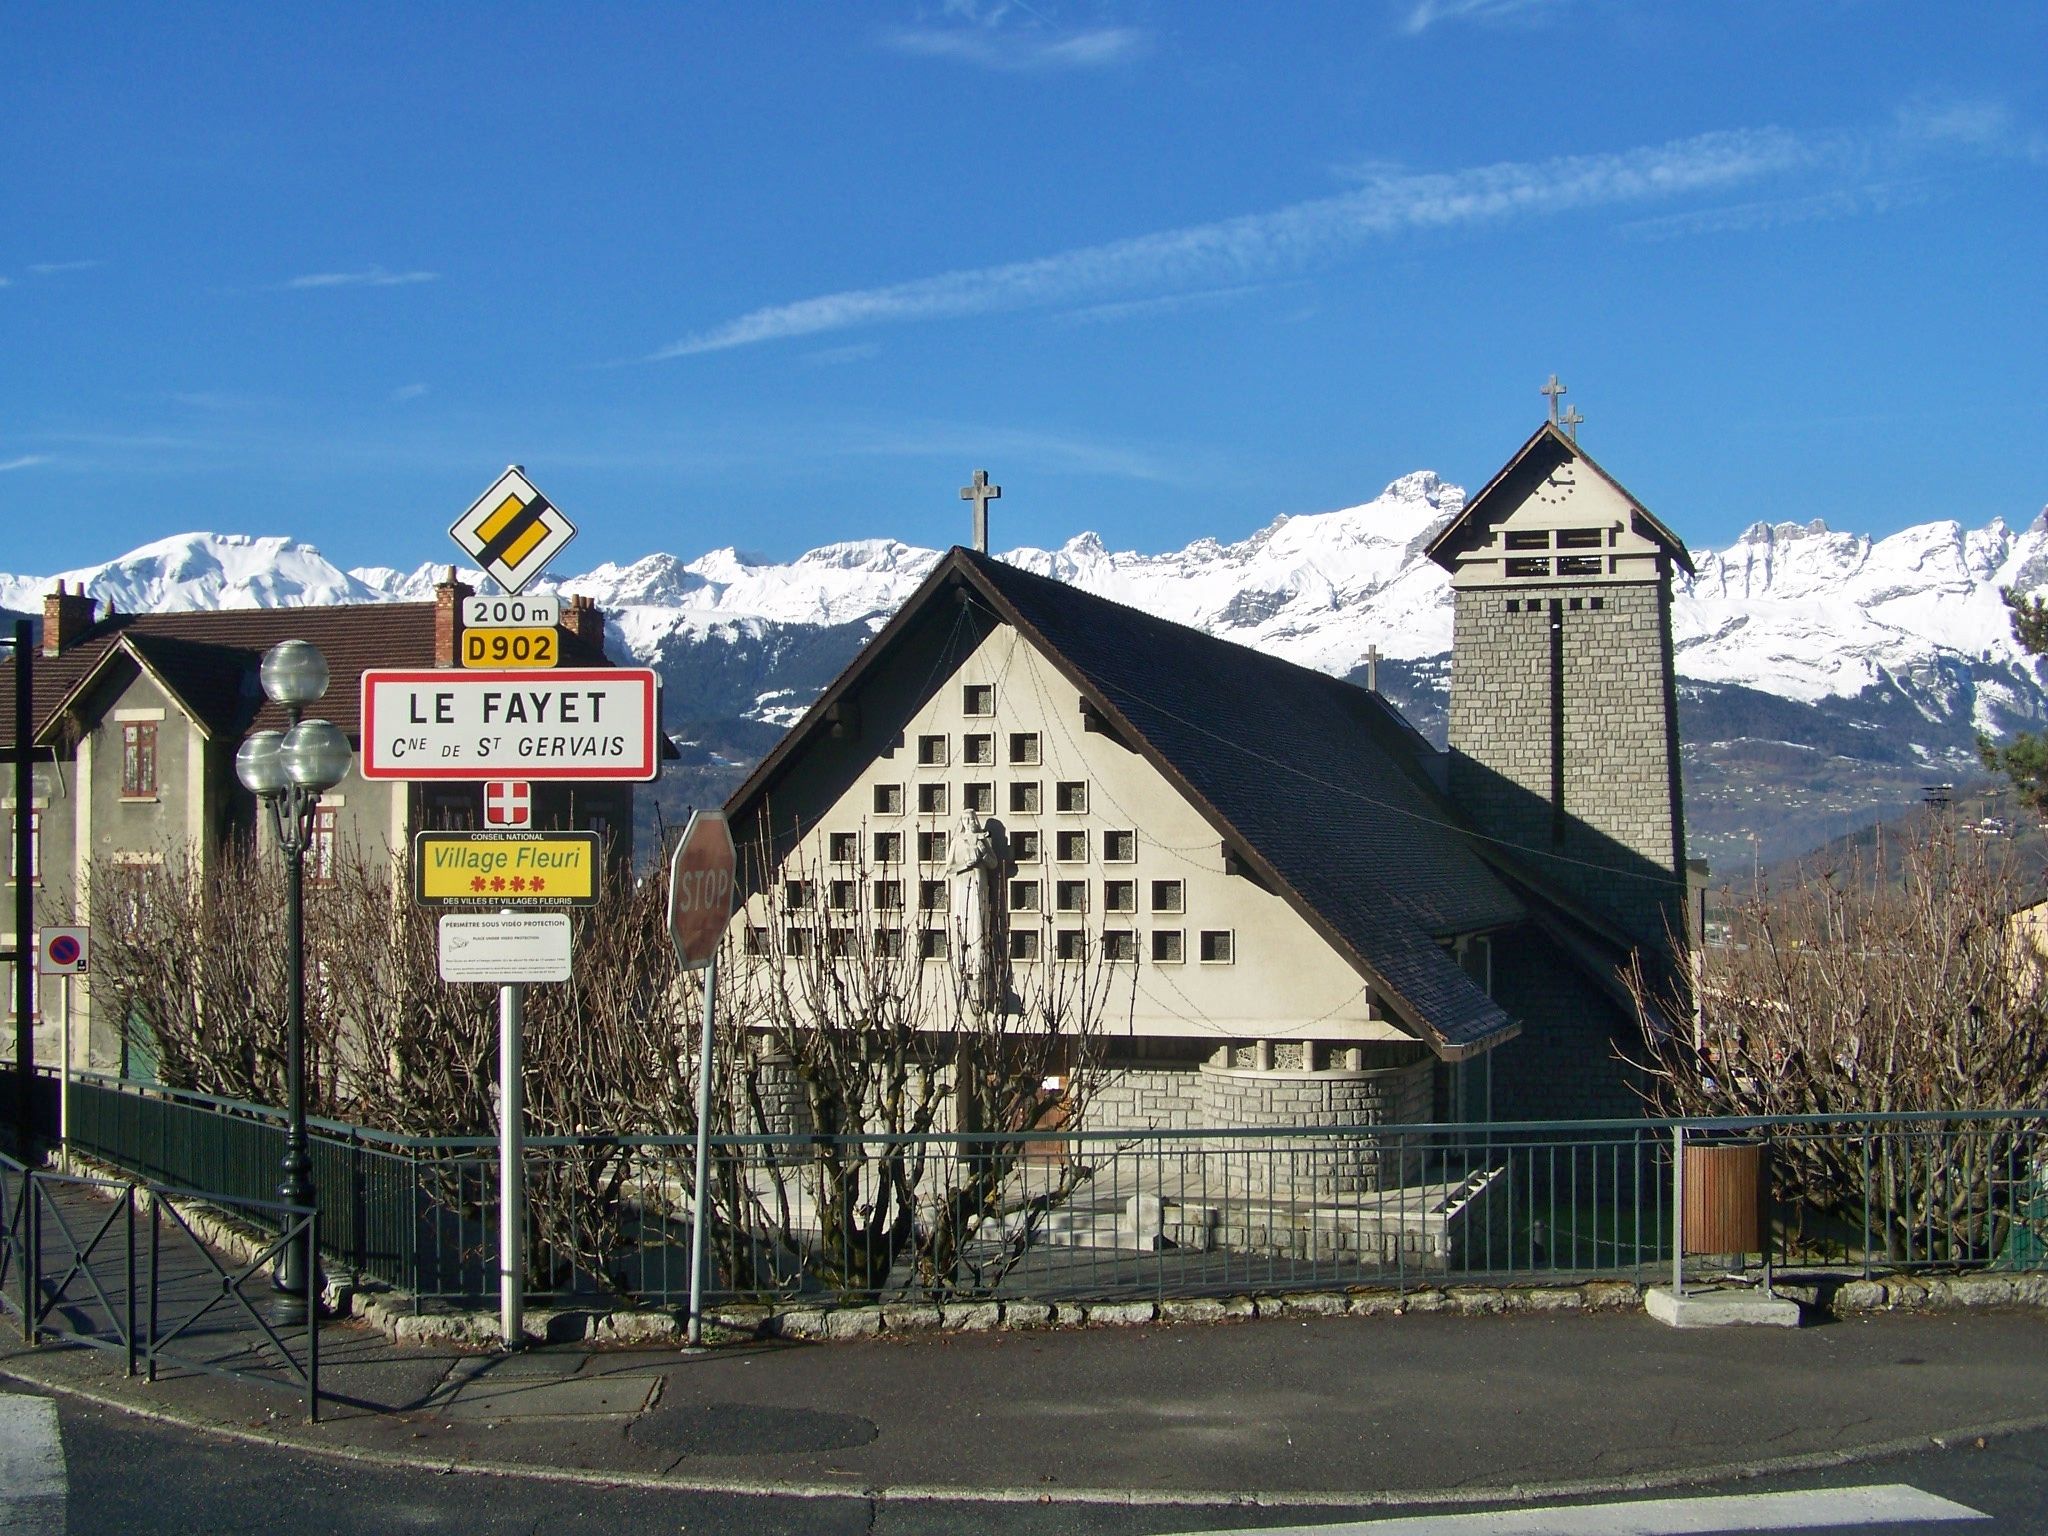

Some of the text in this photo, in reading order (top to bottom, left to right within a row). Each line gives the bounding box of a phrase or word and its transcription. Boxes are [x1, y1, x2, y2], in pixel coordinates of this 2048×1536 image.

[474, 602, 549, 622] 200 m
[468, 635, 551, 661] D902
[409, 692, 606, 724] LE FAYET
[391, 737, 427, 758] CNE
[441, 744, 461, 757] DE
[517, 735, 625, 756] GERVAIS
[471, 833, 544, 841] CONSEIL NATIONAL
[434, 847, 581, 874] Village Fleuri
[443, 897, 573, 905] DES VILLES ET VILLAGES FLEURIS
[680, 868, 728, 913] STOP
